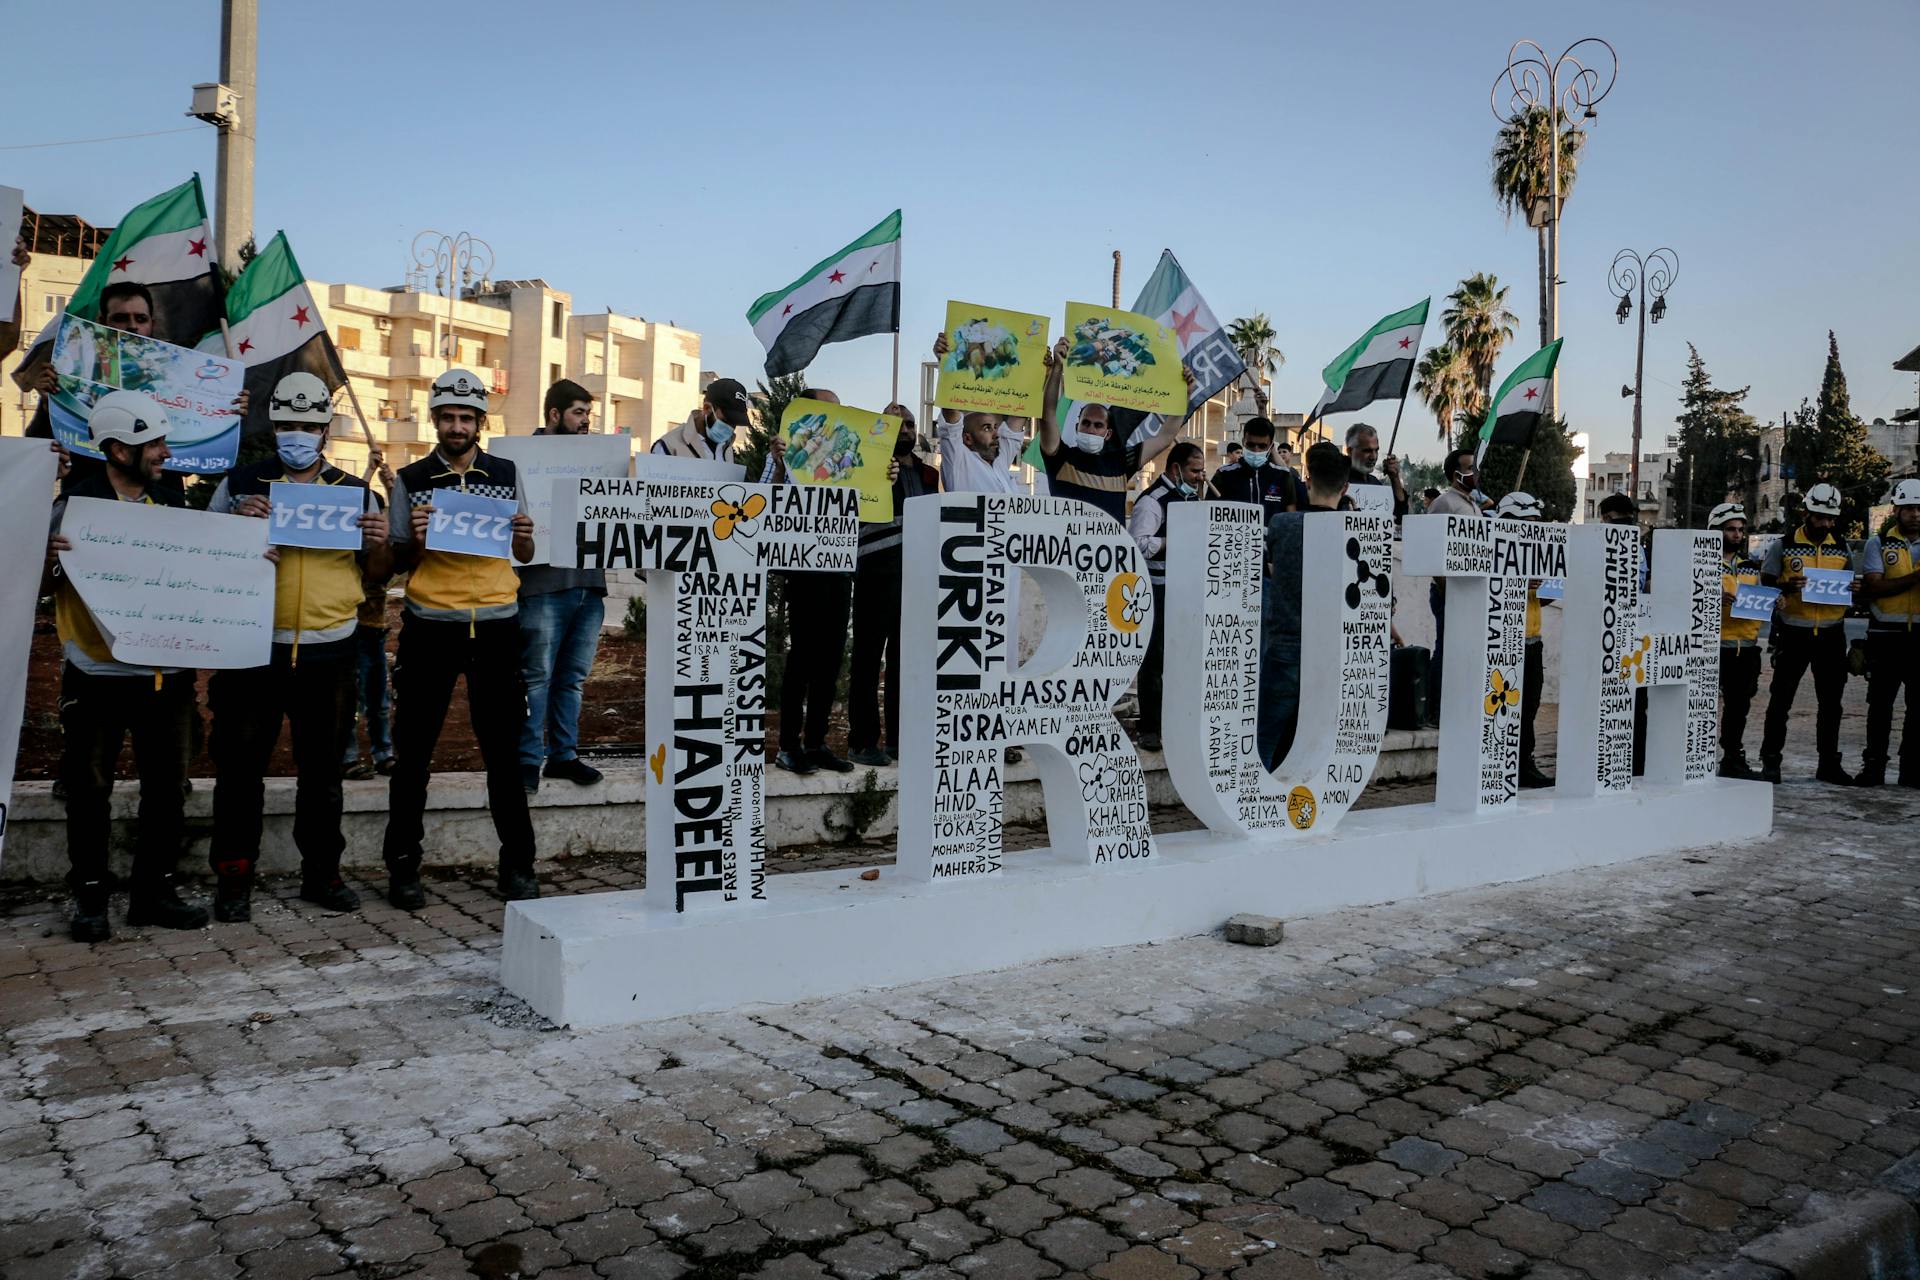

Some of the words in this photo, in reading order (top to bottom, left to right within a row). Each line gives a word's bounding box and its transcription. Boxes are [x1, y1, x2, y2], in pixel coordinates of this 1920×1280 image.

[580, 478, 645, 496] RAHAF
[646, 484, 679, 498] NAJIB
[680, 486, 714, 499] FARES
[771, 485, 859, 517] FATIMA
[1008, 497, 1083, 517] ABDULLAH
[273, 502, 359, 531] 2254
[584, 505, 629, 520] SARAH
[651, 505, 693, 519] WALID
[693, 508, 710, 520] AYA
[432, 508, 511, 541] 2254
[763, 515, 857, 535] ABDUL-KARIM
[987, 498, 1005, 559] SHAM
[1066, 522, 1081, 535] ALI
[1086, 521, 1121, 535] HAYAN
[1345, 516, 1380, 531] RAHAF
[1447, 516, 1492, 542] RAHAF
[817, 535, 858, 547] YOUSSEF
[1520, 523, 1546, 543] SARA
[576, 522, 718, 572] HAMZA
[1362, 544, 1382, 555] AMON
[1382, 519, 1392, 574] SAMER
[1693, 536, 1721, 551] AHMED
[756, 542, 816, 568] MALAK
[815, 551, 853, 569] SANA
[1005, 533, 1072, 566] GHADA
[1075, 543, 1136, 573] GORI
[1493, 537, 1567, 577] FATIMA
[1206, 533, 1222, 598] NOUR
[1464, 558, 1492, 573] DIRAR
[1618, 529, 1630, 599] SAMER
[1630, 530, 1639, 608] MOHAMED
[678, 572, 761, 596] SARAH
[1076, 572, 1104, 583] RATIB
[936, 495, 985, 690] TURKI
[1084, 585, 1106, 596] RATIB
[1504, 589, 1526, 600] SHAM
[1805, 578, 1851, 596] 2254
[699, 597, 757, 617] INSAF
[1602, 527, 1619, 674] SHUROOQ
[1690, 567, 1704, 649] SARAH
[1736, 592, 1775, 611] 2254
[696, 615, 722, 628] ALI
[985, 563, 1005, 672] FAISAL
[1205, 613, 1240, 628] NADA
[1361, 611, 1388, 621] BATOUL
[1487, 577, 1503, 652] DALAL
[1502, 613, 1524, 626] ASIA
[677, 596, 692, 678] MARAM
[695, 631, 739, 643] YAMEN
[1209, 628, 1253, 645] ANAS
[1343, 621, 1386, 635] HAITHAM
[694, 644, 720, 655] ISRA
[1085, 633, 1143, 649] ABDUL
[1346, 634, 1384, 650] ISRA
[1659, 634, 1690, 657] ALAA
[730, 644, 739, 675] DIRAR
[1073, 650, 1123, 667] JAMILA
[1206, 646, 1238, 657] AMER
[1344, 650, 1374, 666] JANA
[1487, 652, 1517, 666] WALID
[700, 655, 709, 682] SHAM
[1204, 659, 1239, 671] KHETAM
[1660, 665, 1683, 679] JOUD
[1206, 672, 1238, 688] ALAA
[1342, 667, 1376, 682] SARAH
[1377, 650, 1388, 713] FATIMA
[734, 624, 766, 763] YASSER
[1000, 679, 1110, 706] HASSAN
[1205, 689, 1239, 701] AHMED
[1601, 686, 1630, 697] RAWDA
[954, 692, 999, 710] RAWDA
[1083, 702, 1107, 713] ALAA
[1203, 700, 1239, 712] HASSAN
[1241, 648, 1257, 755] SHAHEED
[1340, 701, 1367, 719] JANA
[1605, 697, 1632, 714] SHAM
[1688, 698, 1715, 711] NIHAD
[935, 694, 951, 768] SARAH
[953, 713, 1006, 741] ISRA
[1006, 717, 1061, 736] YAMEN
[1072, 723, 1101, 736] AMER
[1339, 718, 1370, 731] SARAH
[1605, 719, 1632, 731] FATIMA
[1209, 715, 1221, 769] SARAH
[1336, 738, 1354, 748] NOUR
[1356, 744, 1378, 756] SHAM
[1706, 711, 1717, 773] FARES
[952, 748, 997, 765] DIRAR
[1109, 755, 1137, 768] SARAH
[1504, 723, 1519, 803] YASSER
[726, 763, 764, 777] SIHAM
[1117, 768, 1144, 786] TOKA
[1327, 764, 1363, 783] RIAD
[1481, 771, 1503, 780] NAJIB
[937, 766, 1000, 794] ALAA
[1481, 780, 1503, 791] FARES
[674, 683, 723, 913] HADEEL
[731, 778, 742, 820] NIHAD
[934, 793, 976, 813] HIND
[1322, 789, 1349, 804] AMON
[1481, 794, 1503, 805] INSAF
[1089, 802, 1145, 826] KHALED
[722, 806, 733, 847] DALAL
[934, 820, 975, 839] TOKA
[987, 791, 1003, 874] KHADIJA
[1087, 824, 1126, 840] MOHAMED
[931, 842, 976, 857] MOHAMED
[975, 808, 987, 874] AMMAR
[1095, 839, 1150, 863] AYOUB
[750, 825, 766, 900] MULHAM
[933, 860, 975, 878] MAHER
[724, 852, 737, 902] FARES
